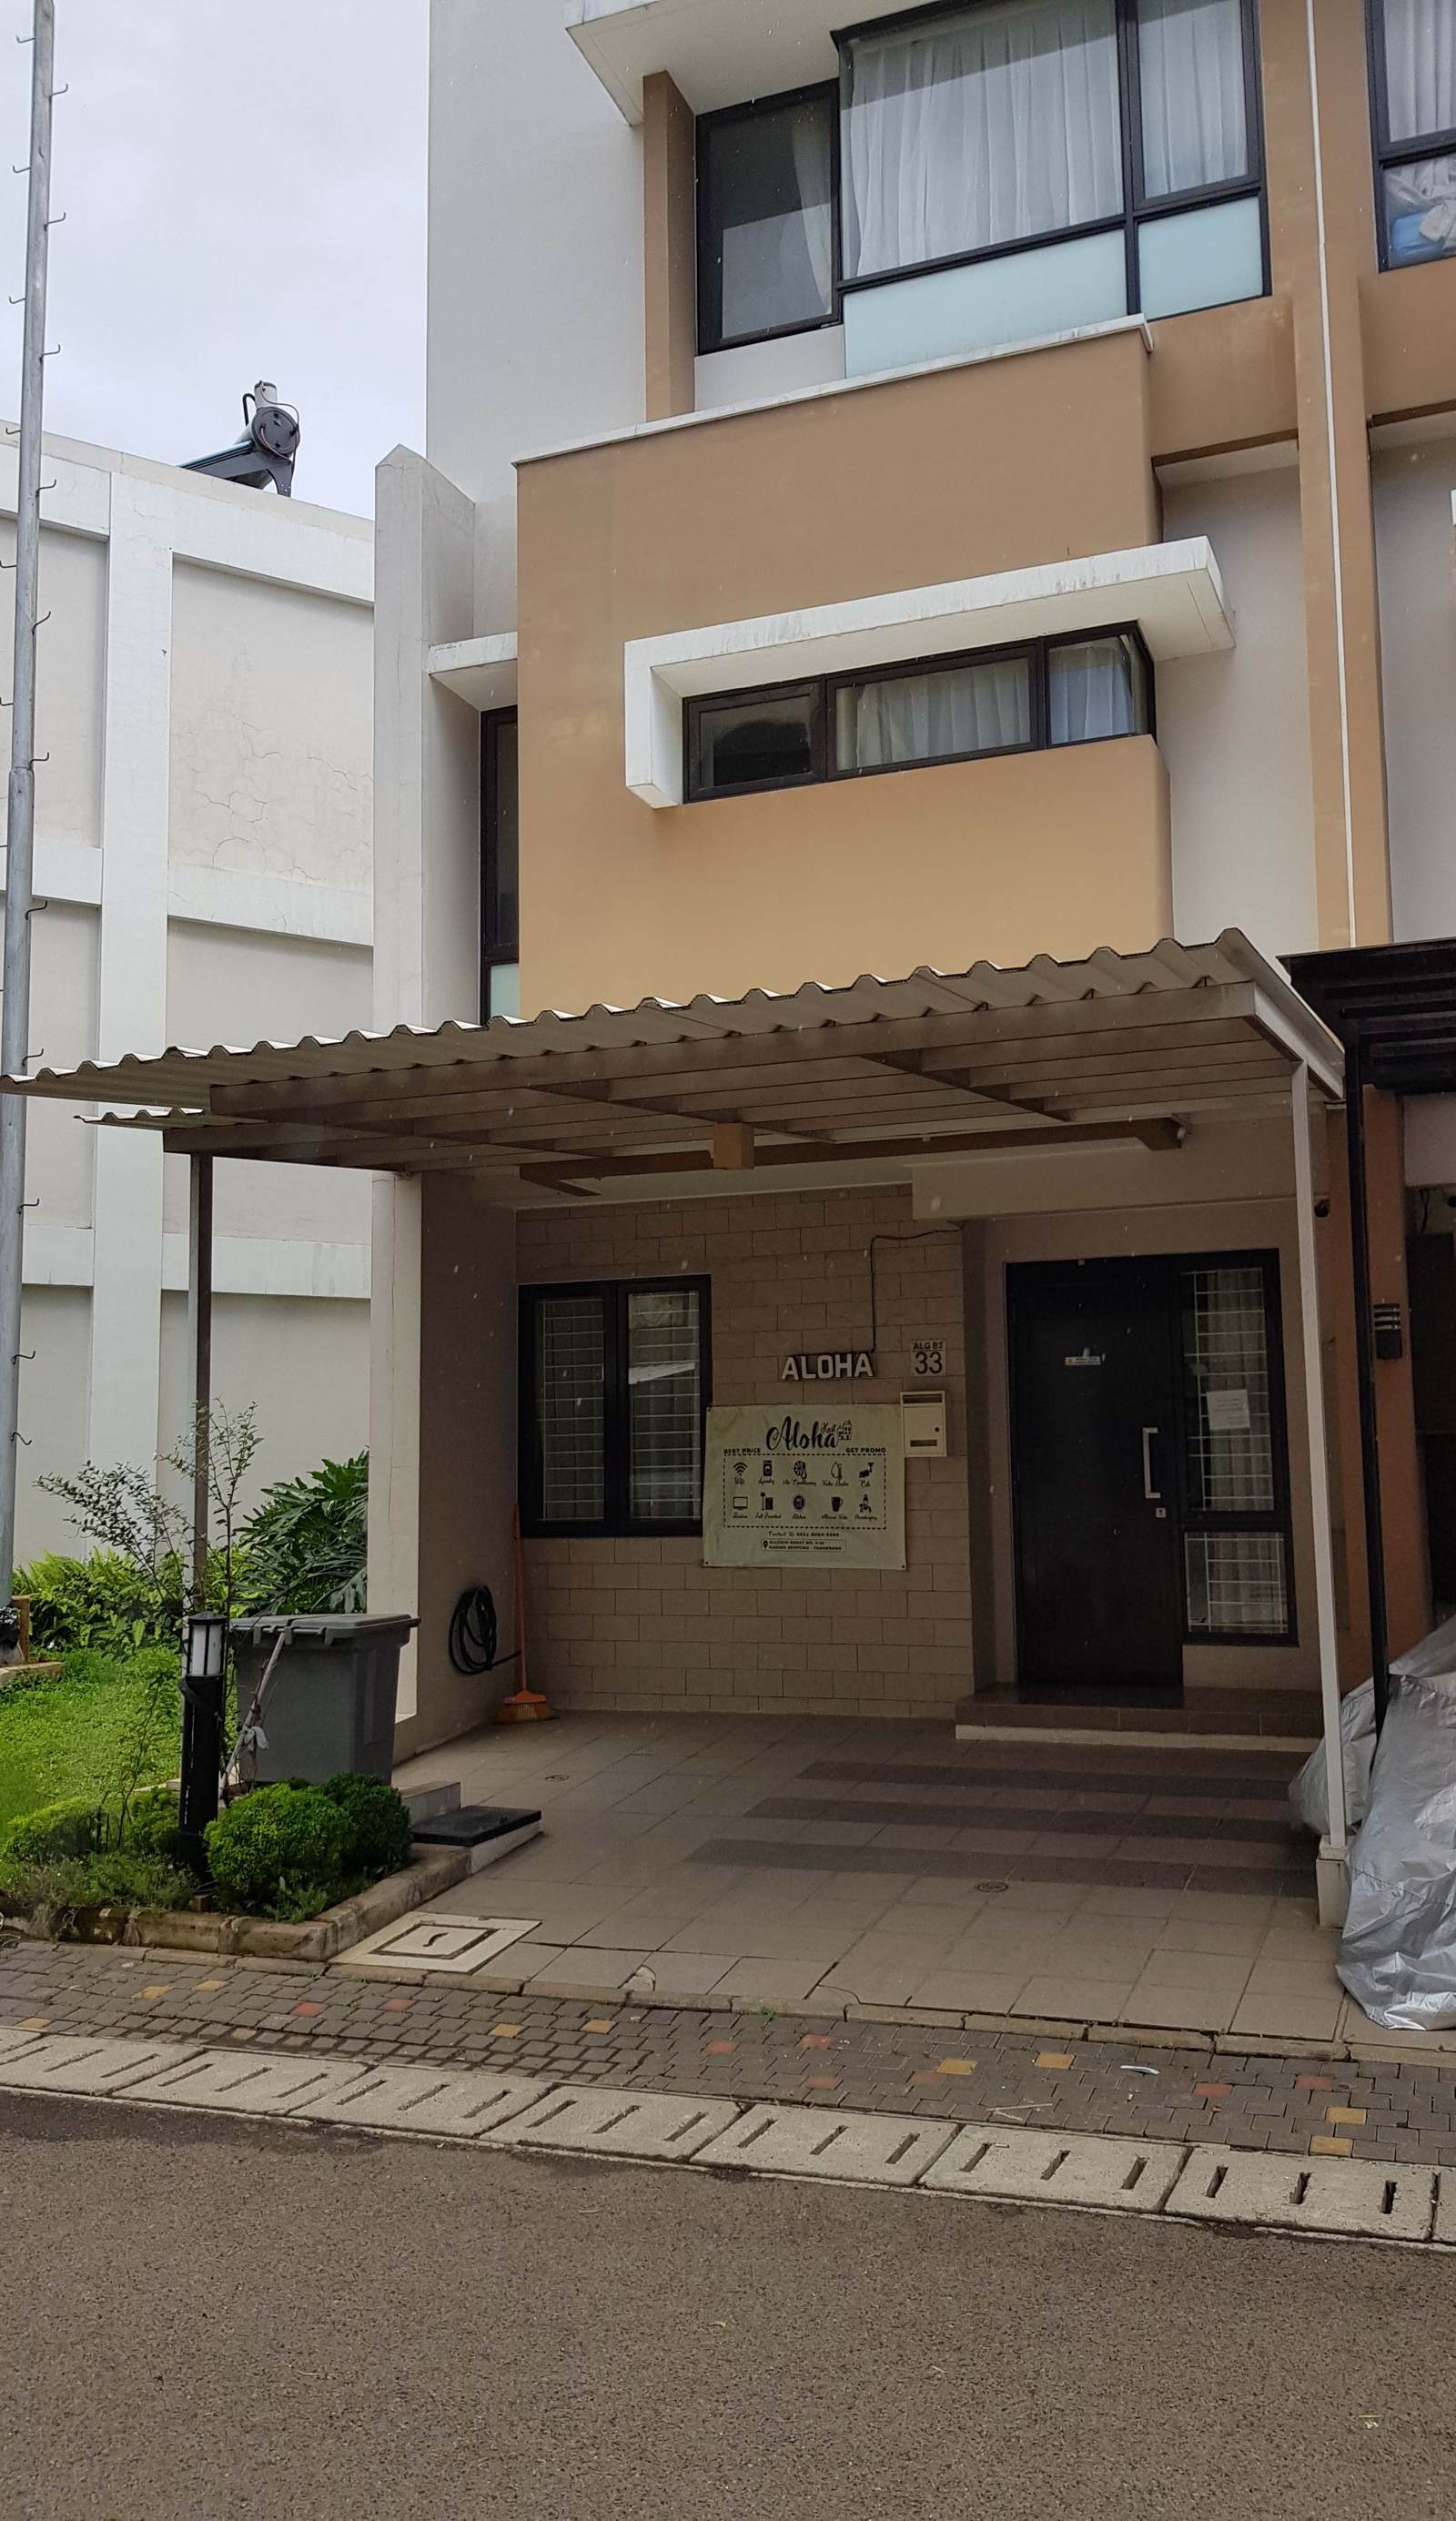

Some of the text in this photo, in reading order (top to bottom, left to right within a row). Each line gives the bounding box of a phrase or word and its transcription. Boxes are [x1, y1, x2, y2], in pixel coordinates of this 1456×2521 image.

[781, 1352, 874, 1381] ALOHA
[915, 1352, 942, 1374] 33
[766, 1415, 838, 1451] Aloha
